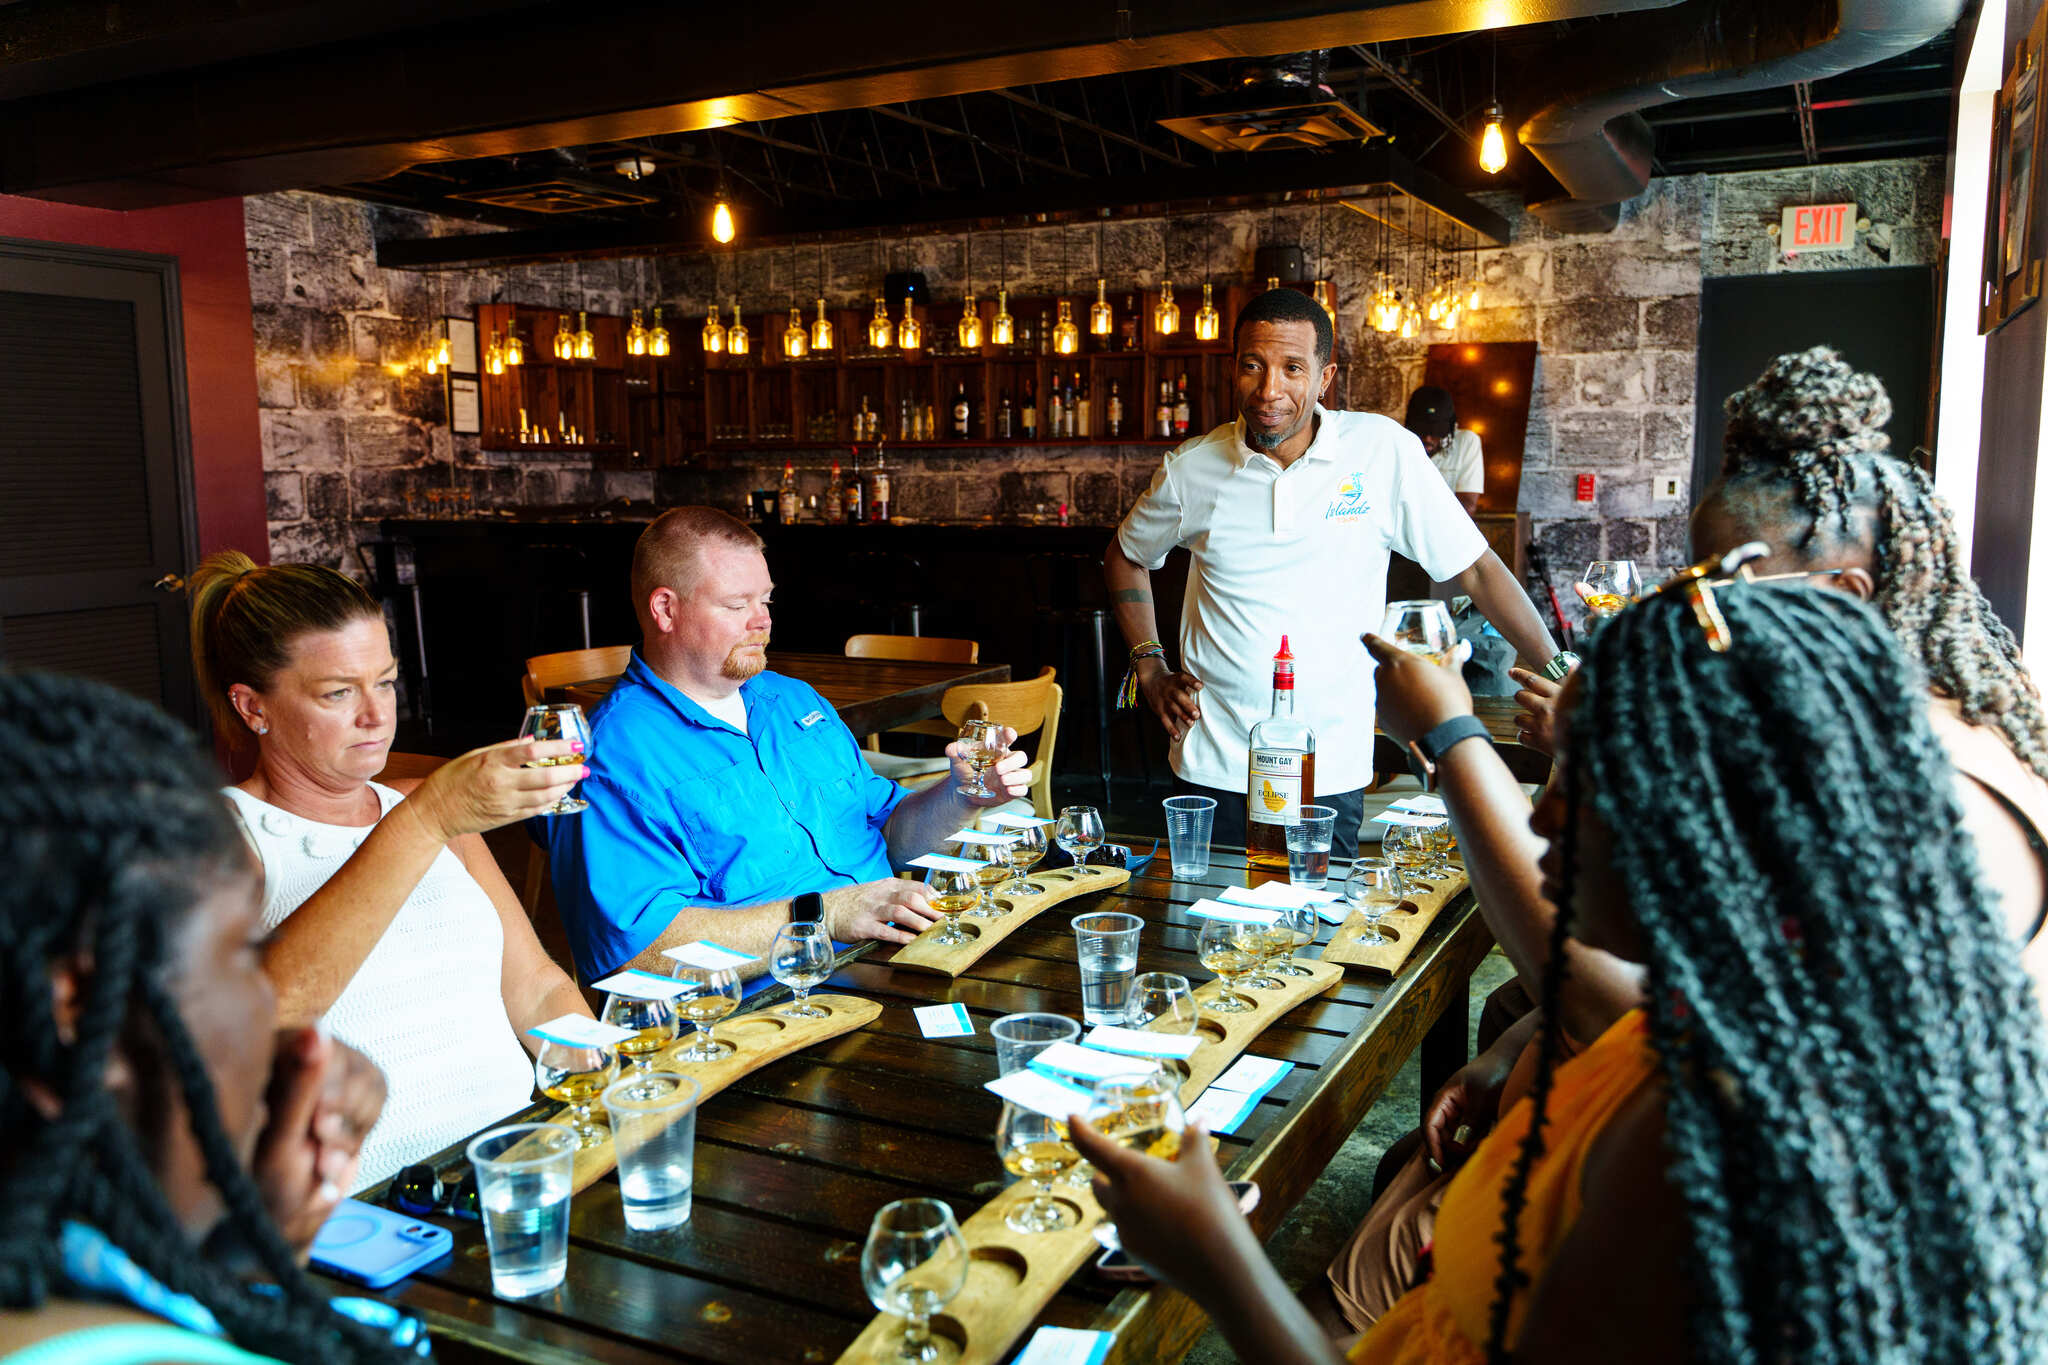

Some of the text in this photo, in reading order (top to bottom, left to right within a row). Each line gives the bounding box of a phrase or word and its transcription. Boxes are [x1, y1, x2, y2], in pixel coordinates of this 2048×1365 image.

[1794, 205, 1848, 245] EXIT
[1256, 754, 1292, 765] MOUNT GAY
[1258, 789, 1289, 799] ECLIPSE
